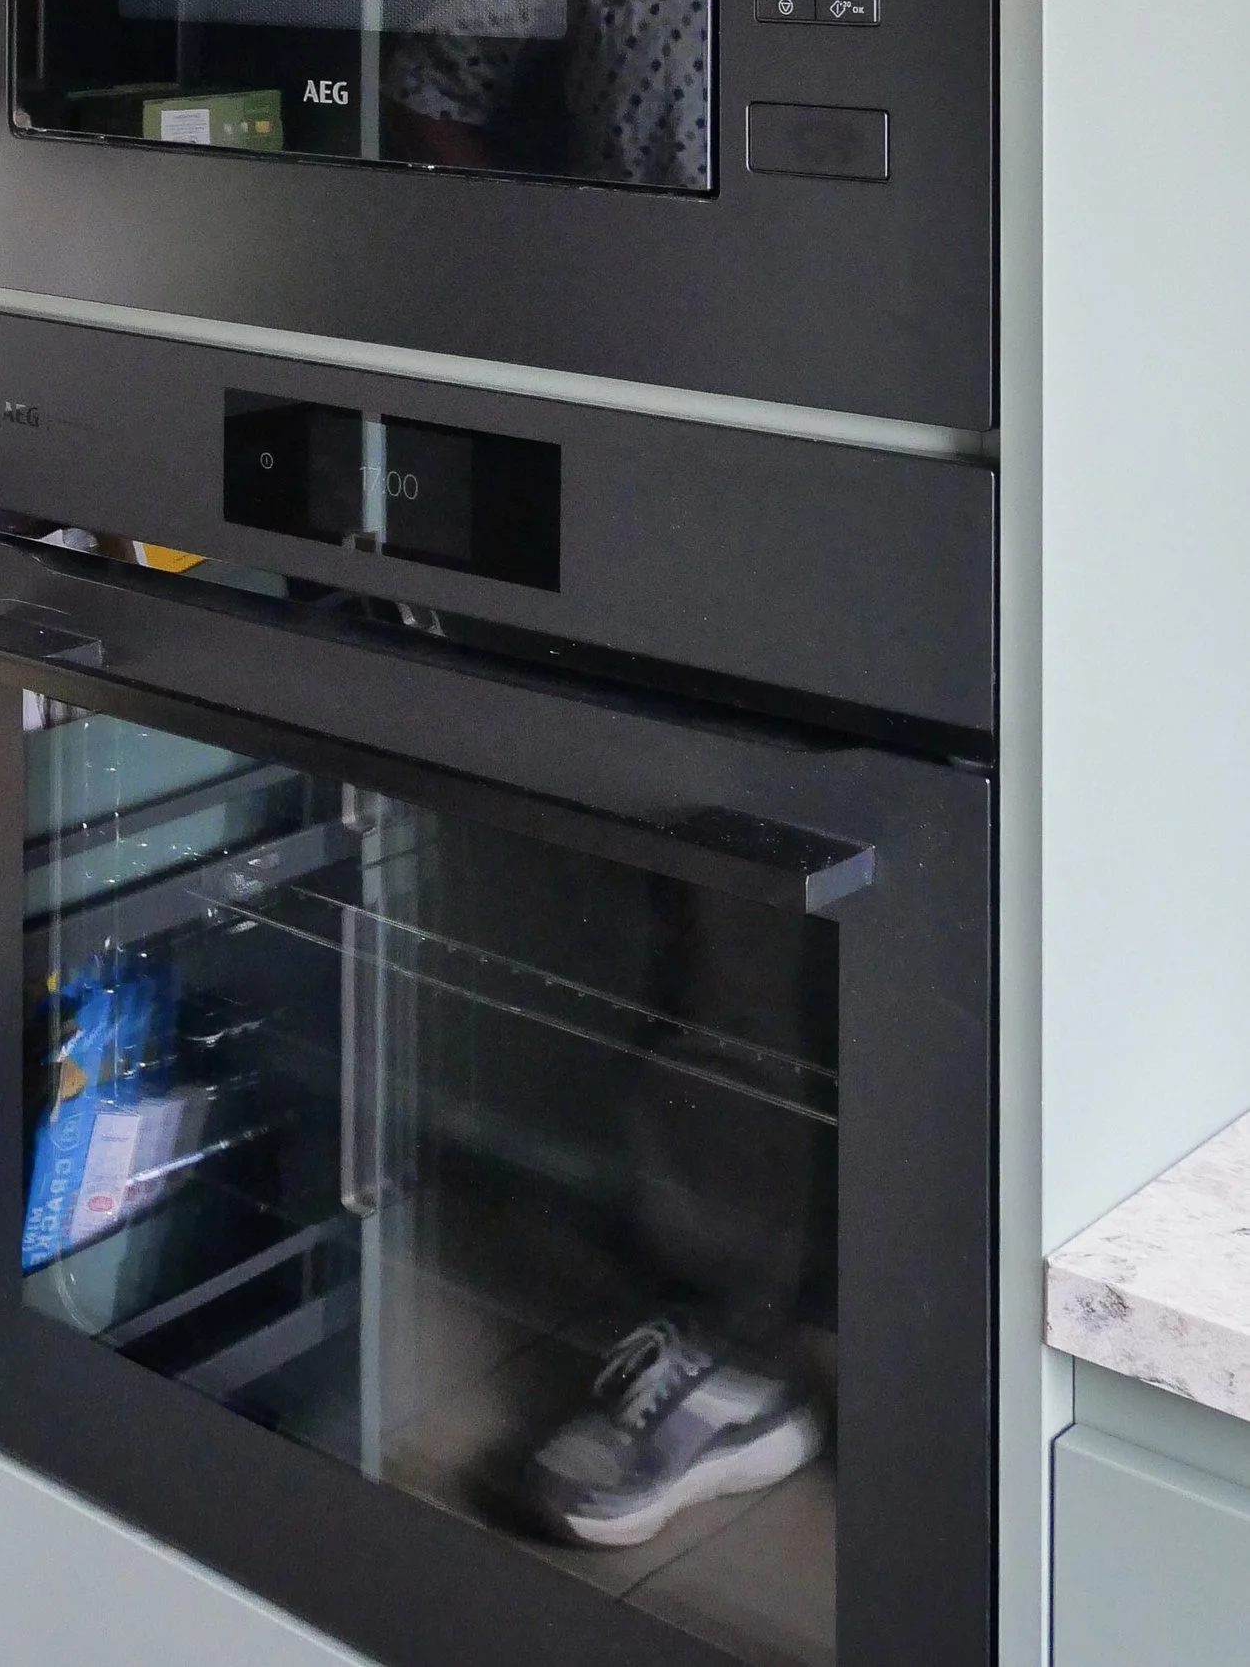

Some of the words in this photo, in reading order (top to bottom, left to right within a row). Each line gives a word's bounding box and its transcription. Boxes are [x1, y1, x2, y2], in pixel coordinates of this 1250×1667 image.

[852, 6, 865, 14] OK
[303, 79, 349, 105] AEG
[2, 401, 40, 427] AEG
[359, 466, 419, 500] 17:00
